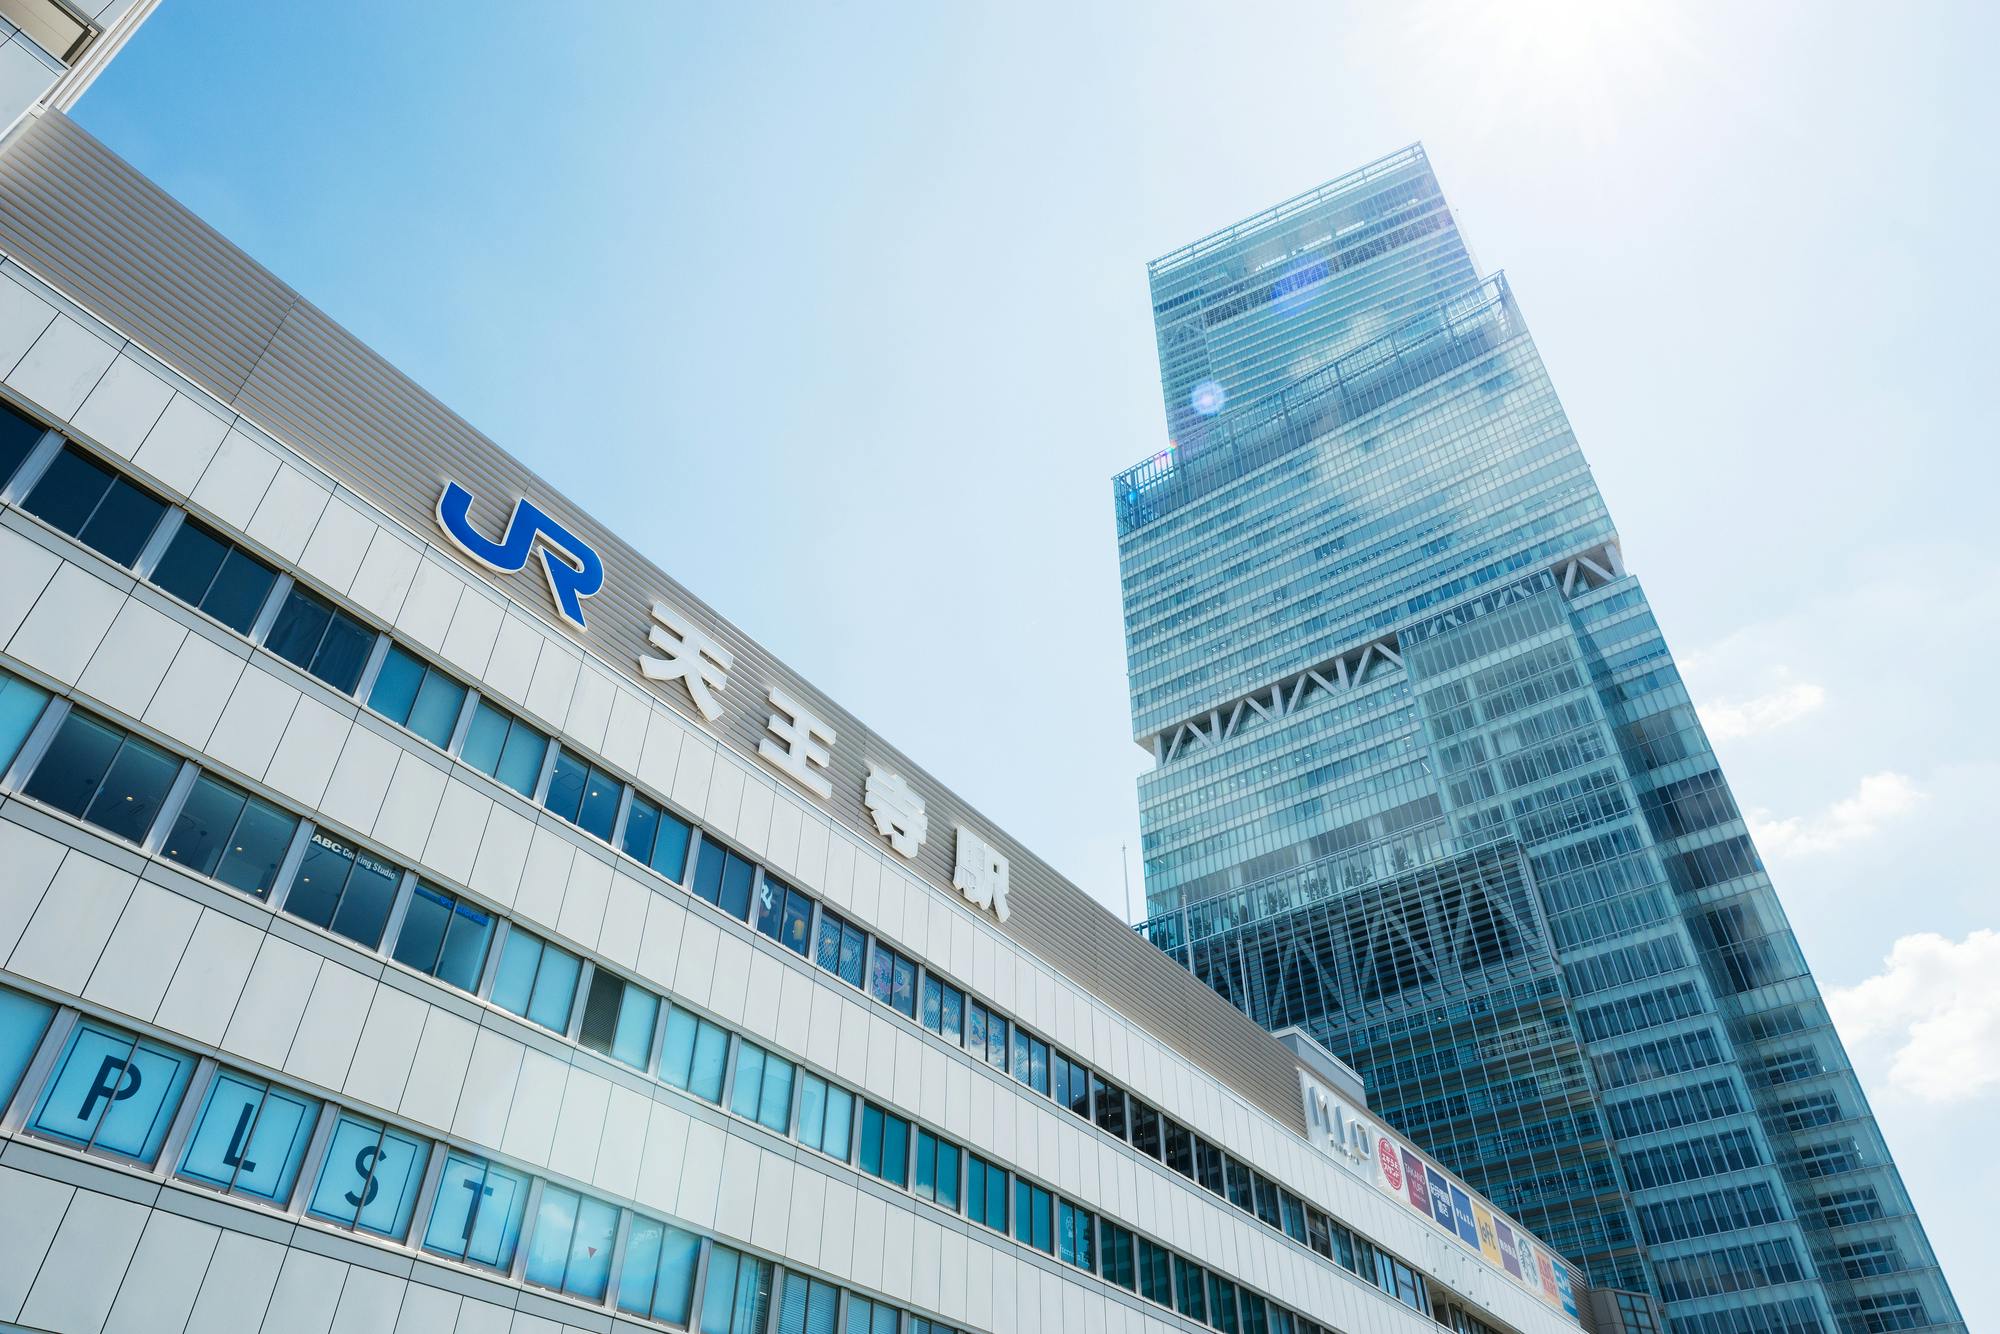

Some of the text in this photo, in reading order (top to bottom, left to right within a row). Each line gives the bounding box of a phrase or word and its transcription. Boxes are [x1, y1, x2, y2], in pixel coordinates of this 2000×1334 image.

[436, 480, 1010, 923] JR 天王寺駅
[312, 834, 342, 854] ABC
[372, 863, 396, 880] Studio
